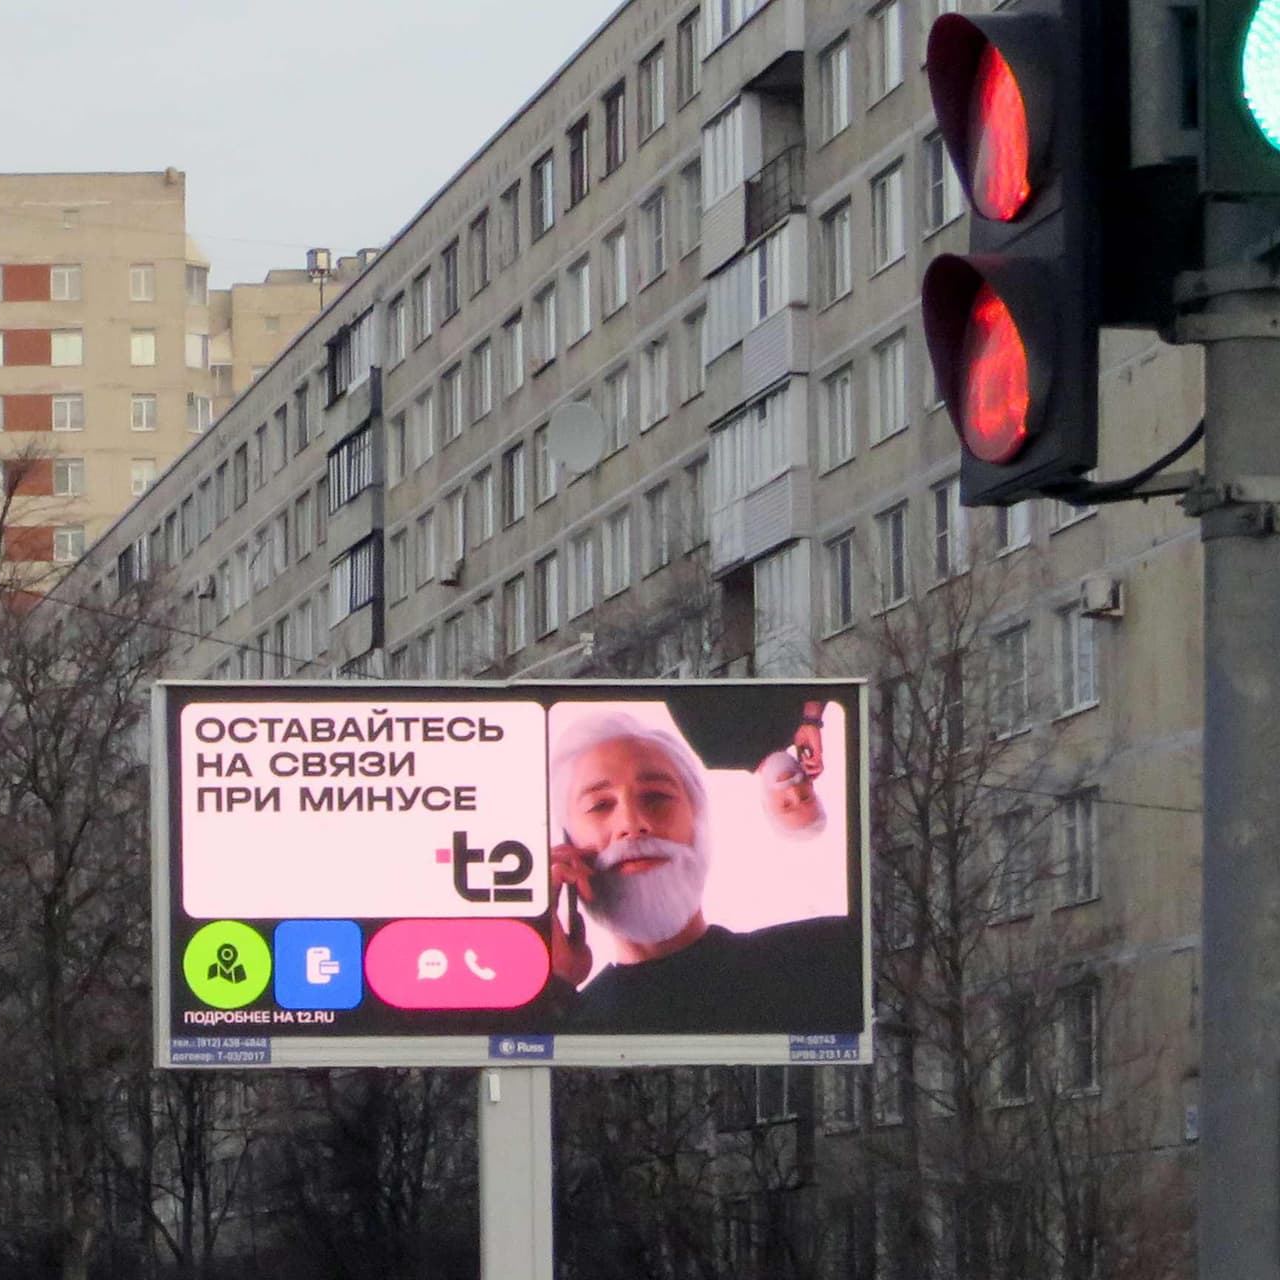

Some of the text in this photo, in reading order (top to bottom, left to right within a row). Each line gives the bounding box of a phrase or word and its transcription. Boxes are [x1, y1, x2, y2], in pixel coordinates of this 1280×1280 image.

[195, 708, 505, 743] ОСТАВАЙТЕСЬ
[197, 751, 415, 777] НА СВЯЗИ
[197, 786, 477, 812] ПРИ МИНУСЕ
[436, 831, 534, 903] t2
[184, 1010, 271, 1025] ПОДРОБНЕЕ
[273, 1010, 295, 1023] НА
